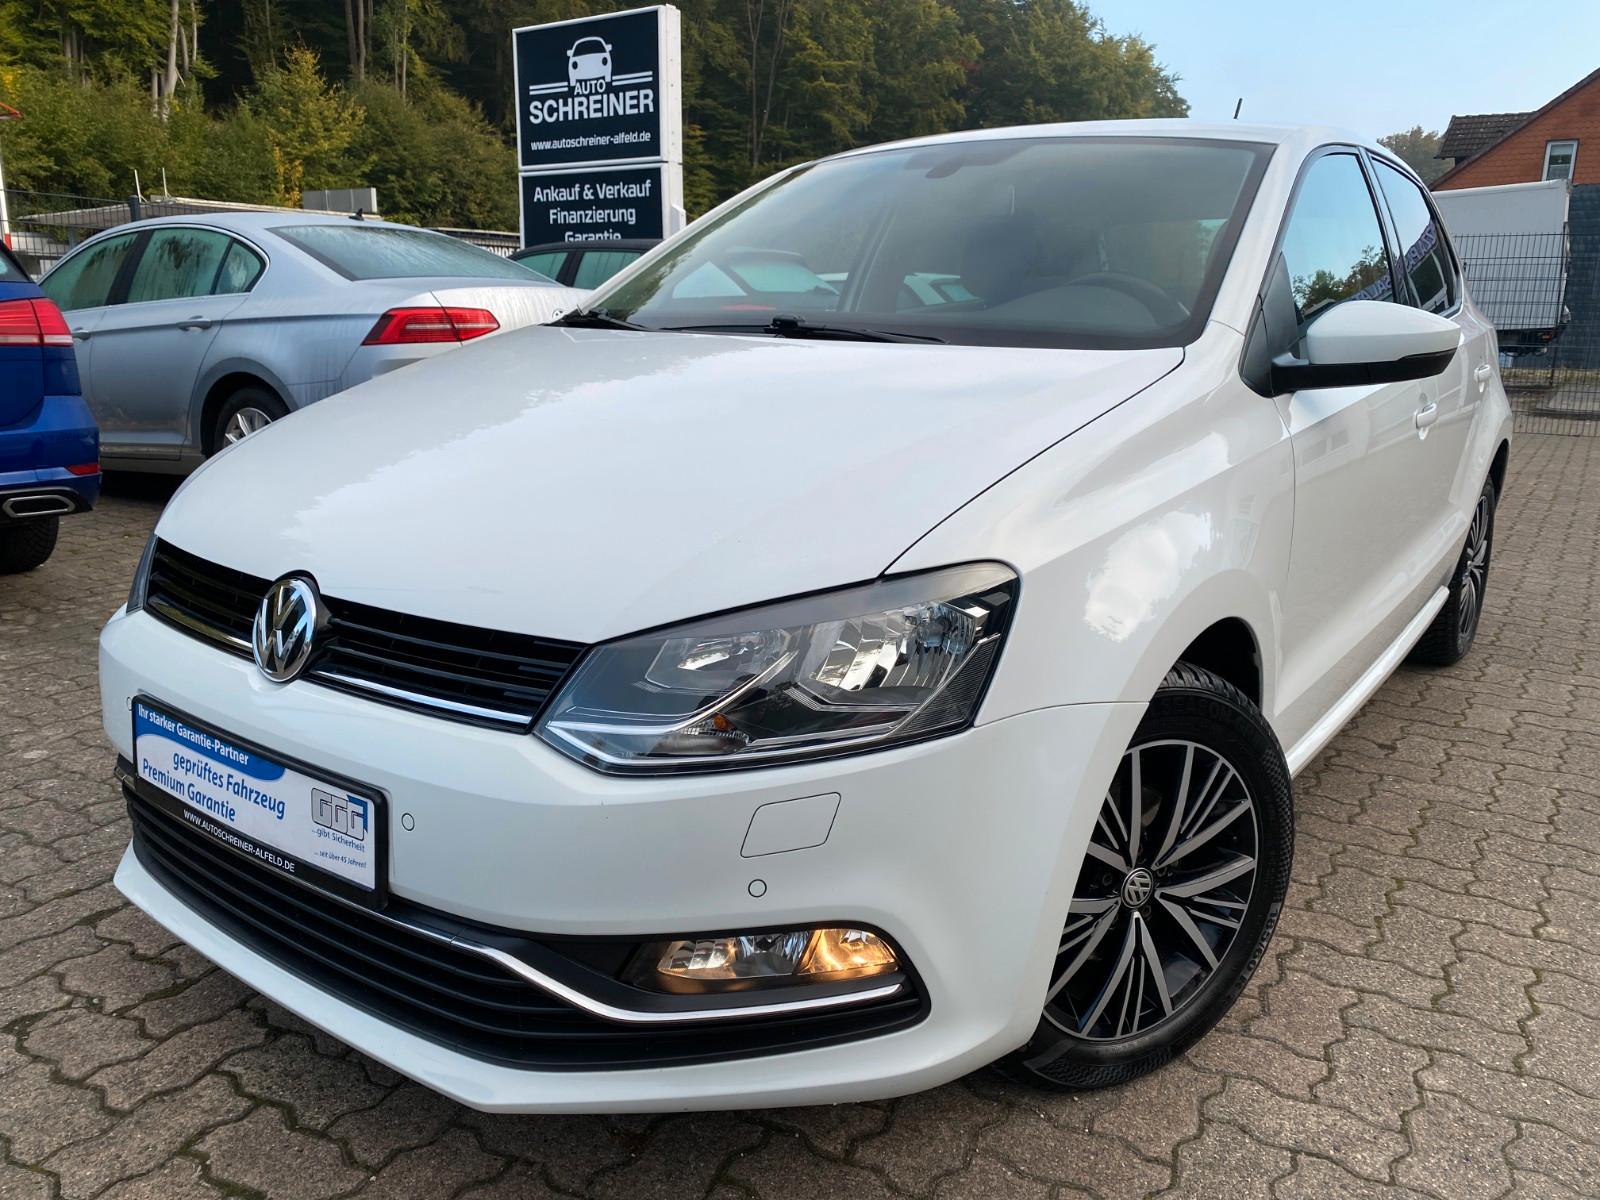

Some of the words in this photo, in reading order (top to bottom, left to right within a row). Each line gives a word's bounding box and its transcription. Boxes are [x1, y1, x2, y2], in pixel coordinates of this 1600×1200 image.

[574, 79, 606, 95] AUTO
[529, 89, 654, 124] SCHREINER
[531, 131, 651, 151] www.autoschreiner-alfeld.de
[534, 184, 581, 202] Ankauf
[583, 184, 594, 200] &
[596, 180, 652, 199] Verkauf
[549, 206, 636, 224] Finanzierung
[138, 703, 148, 719] Ihr
[149, 711, 175, 733] starker
[176, 723, 249, 766] Garantie-Partner
[142, 758, 185, 796] Premium
[187, 783, 236, 822] Garantie
[173, 752, 224, 788] geprüftes
[226, 773, 286, 820] Fahrzeug
[332, 832, 365, 853] Sicherheit
